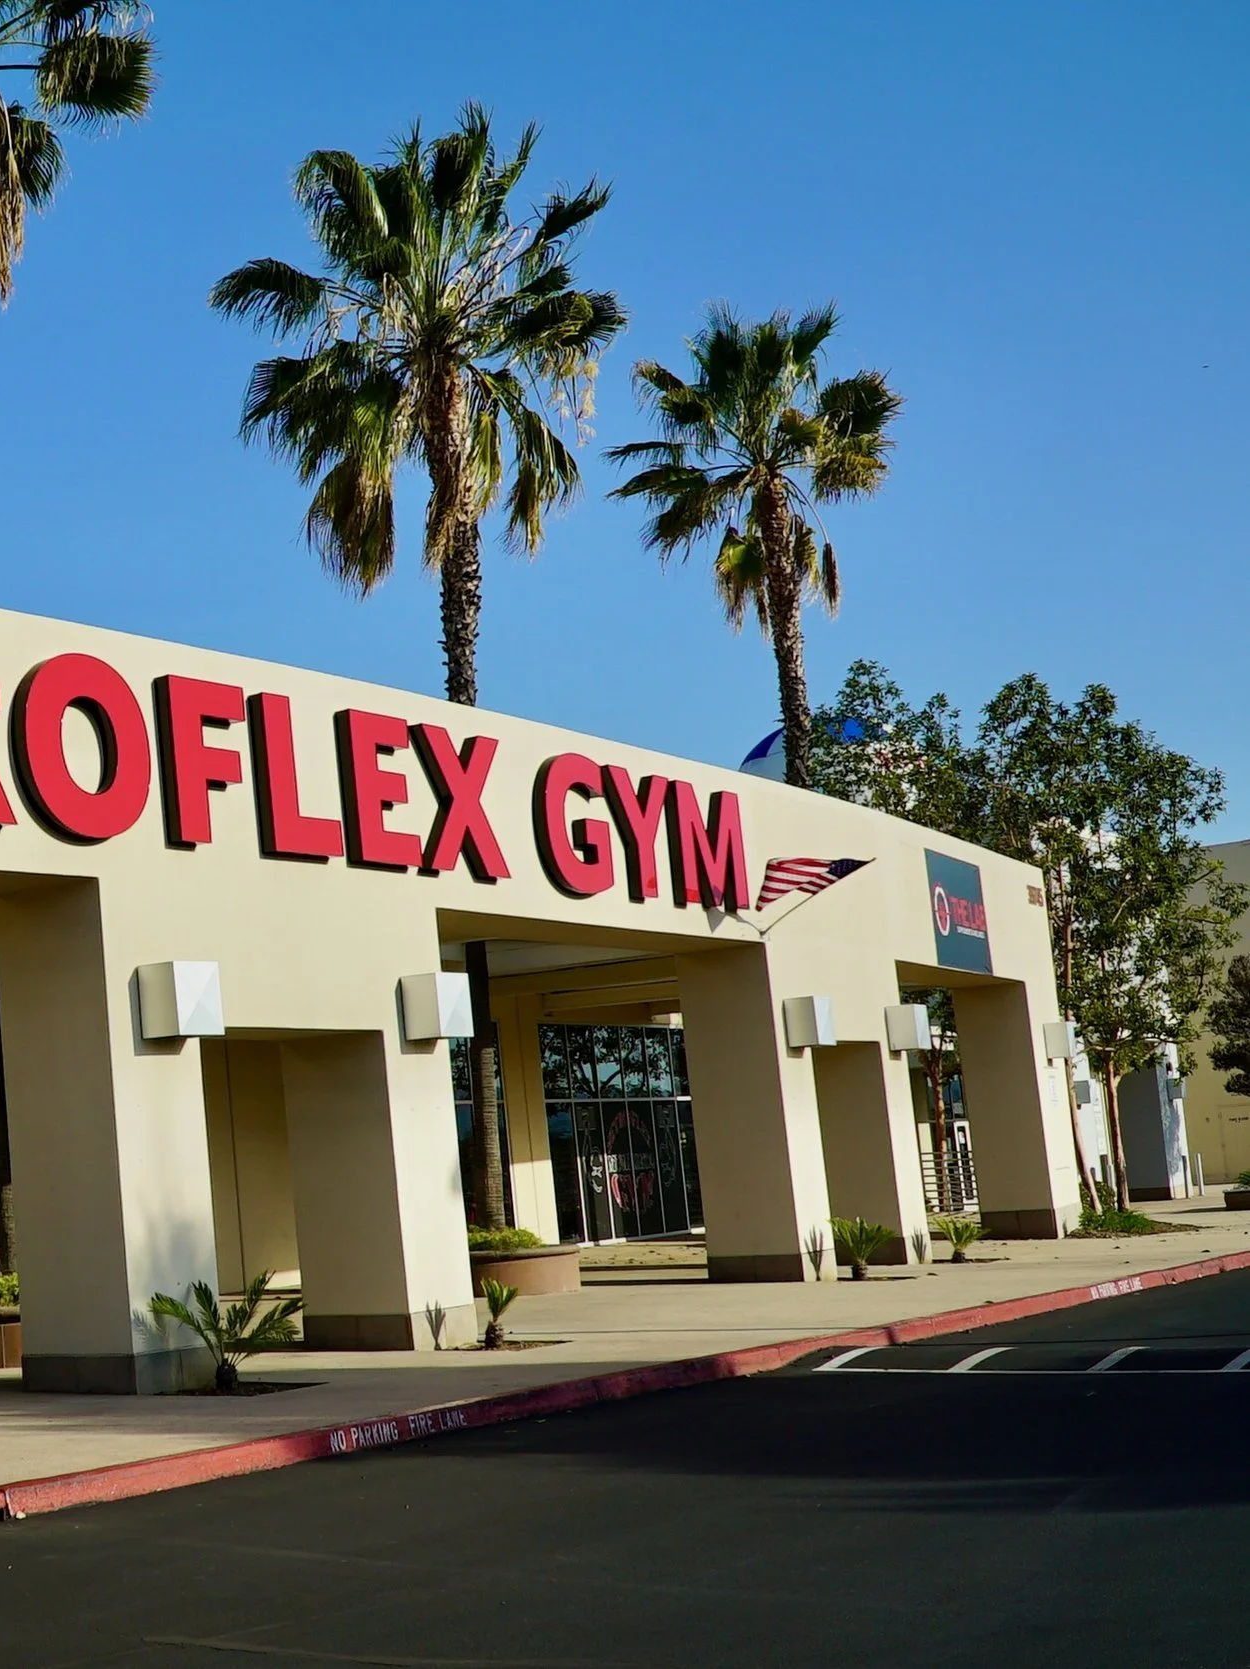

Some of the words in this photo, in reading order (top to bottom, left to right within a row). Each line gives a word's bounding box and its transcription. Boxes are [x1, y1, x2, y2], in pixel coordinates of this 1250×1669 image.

[535, 752, 749, 909] GYM
[330, 1430, 346, 1453] NO
[350, 1421, 399, 1449] PARKING
[408, 1412, 436, 1436] FIRE
[438, 1409, 468, 1431] LANE
